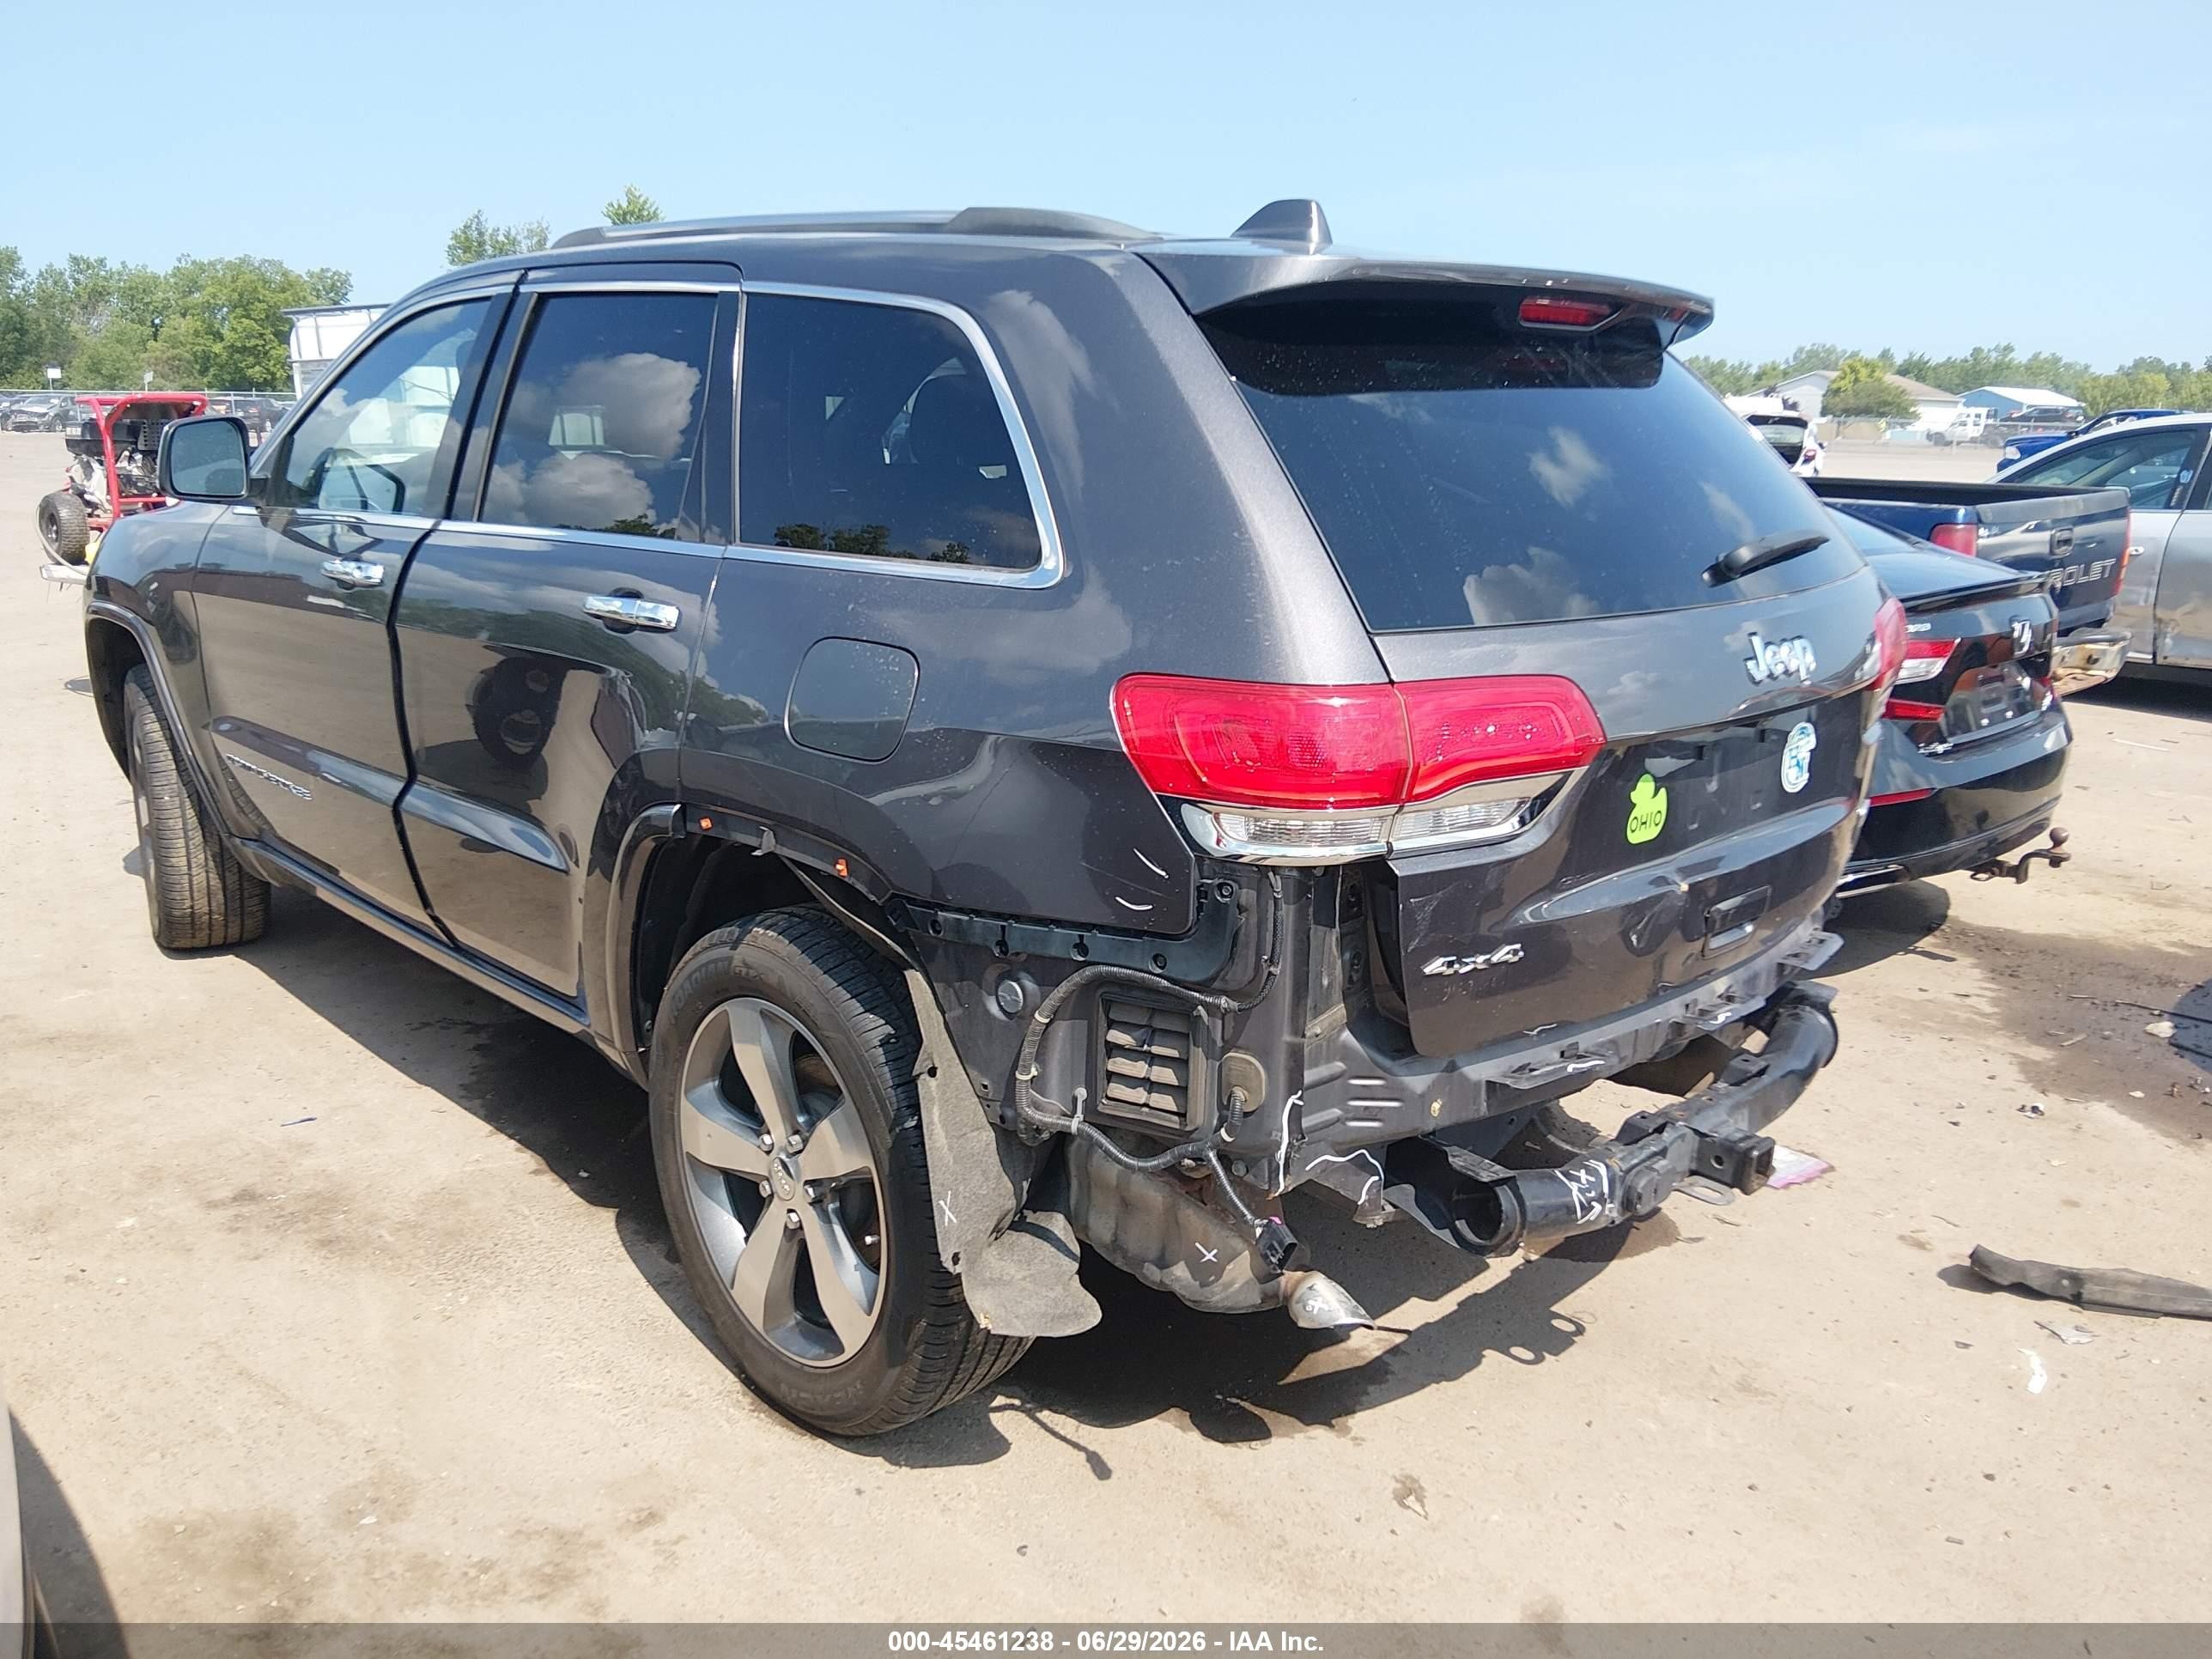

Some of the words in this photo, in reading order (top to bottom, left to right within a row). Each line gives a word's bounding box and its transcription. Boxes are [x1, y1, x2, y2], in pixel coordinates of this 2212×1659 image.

[2048, 558, 2117, 587] ROLET
[1745, 635, 1816, 684] Jeep
[1629, 810, 1662, 834] OHIO
